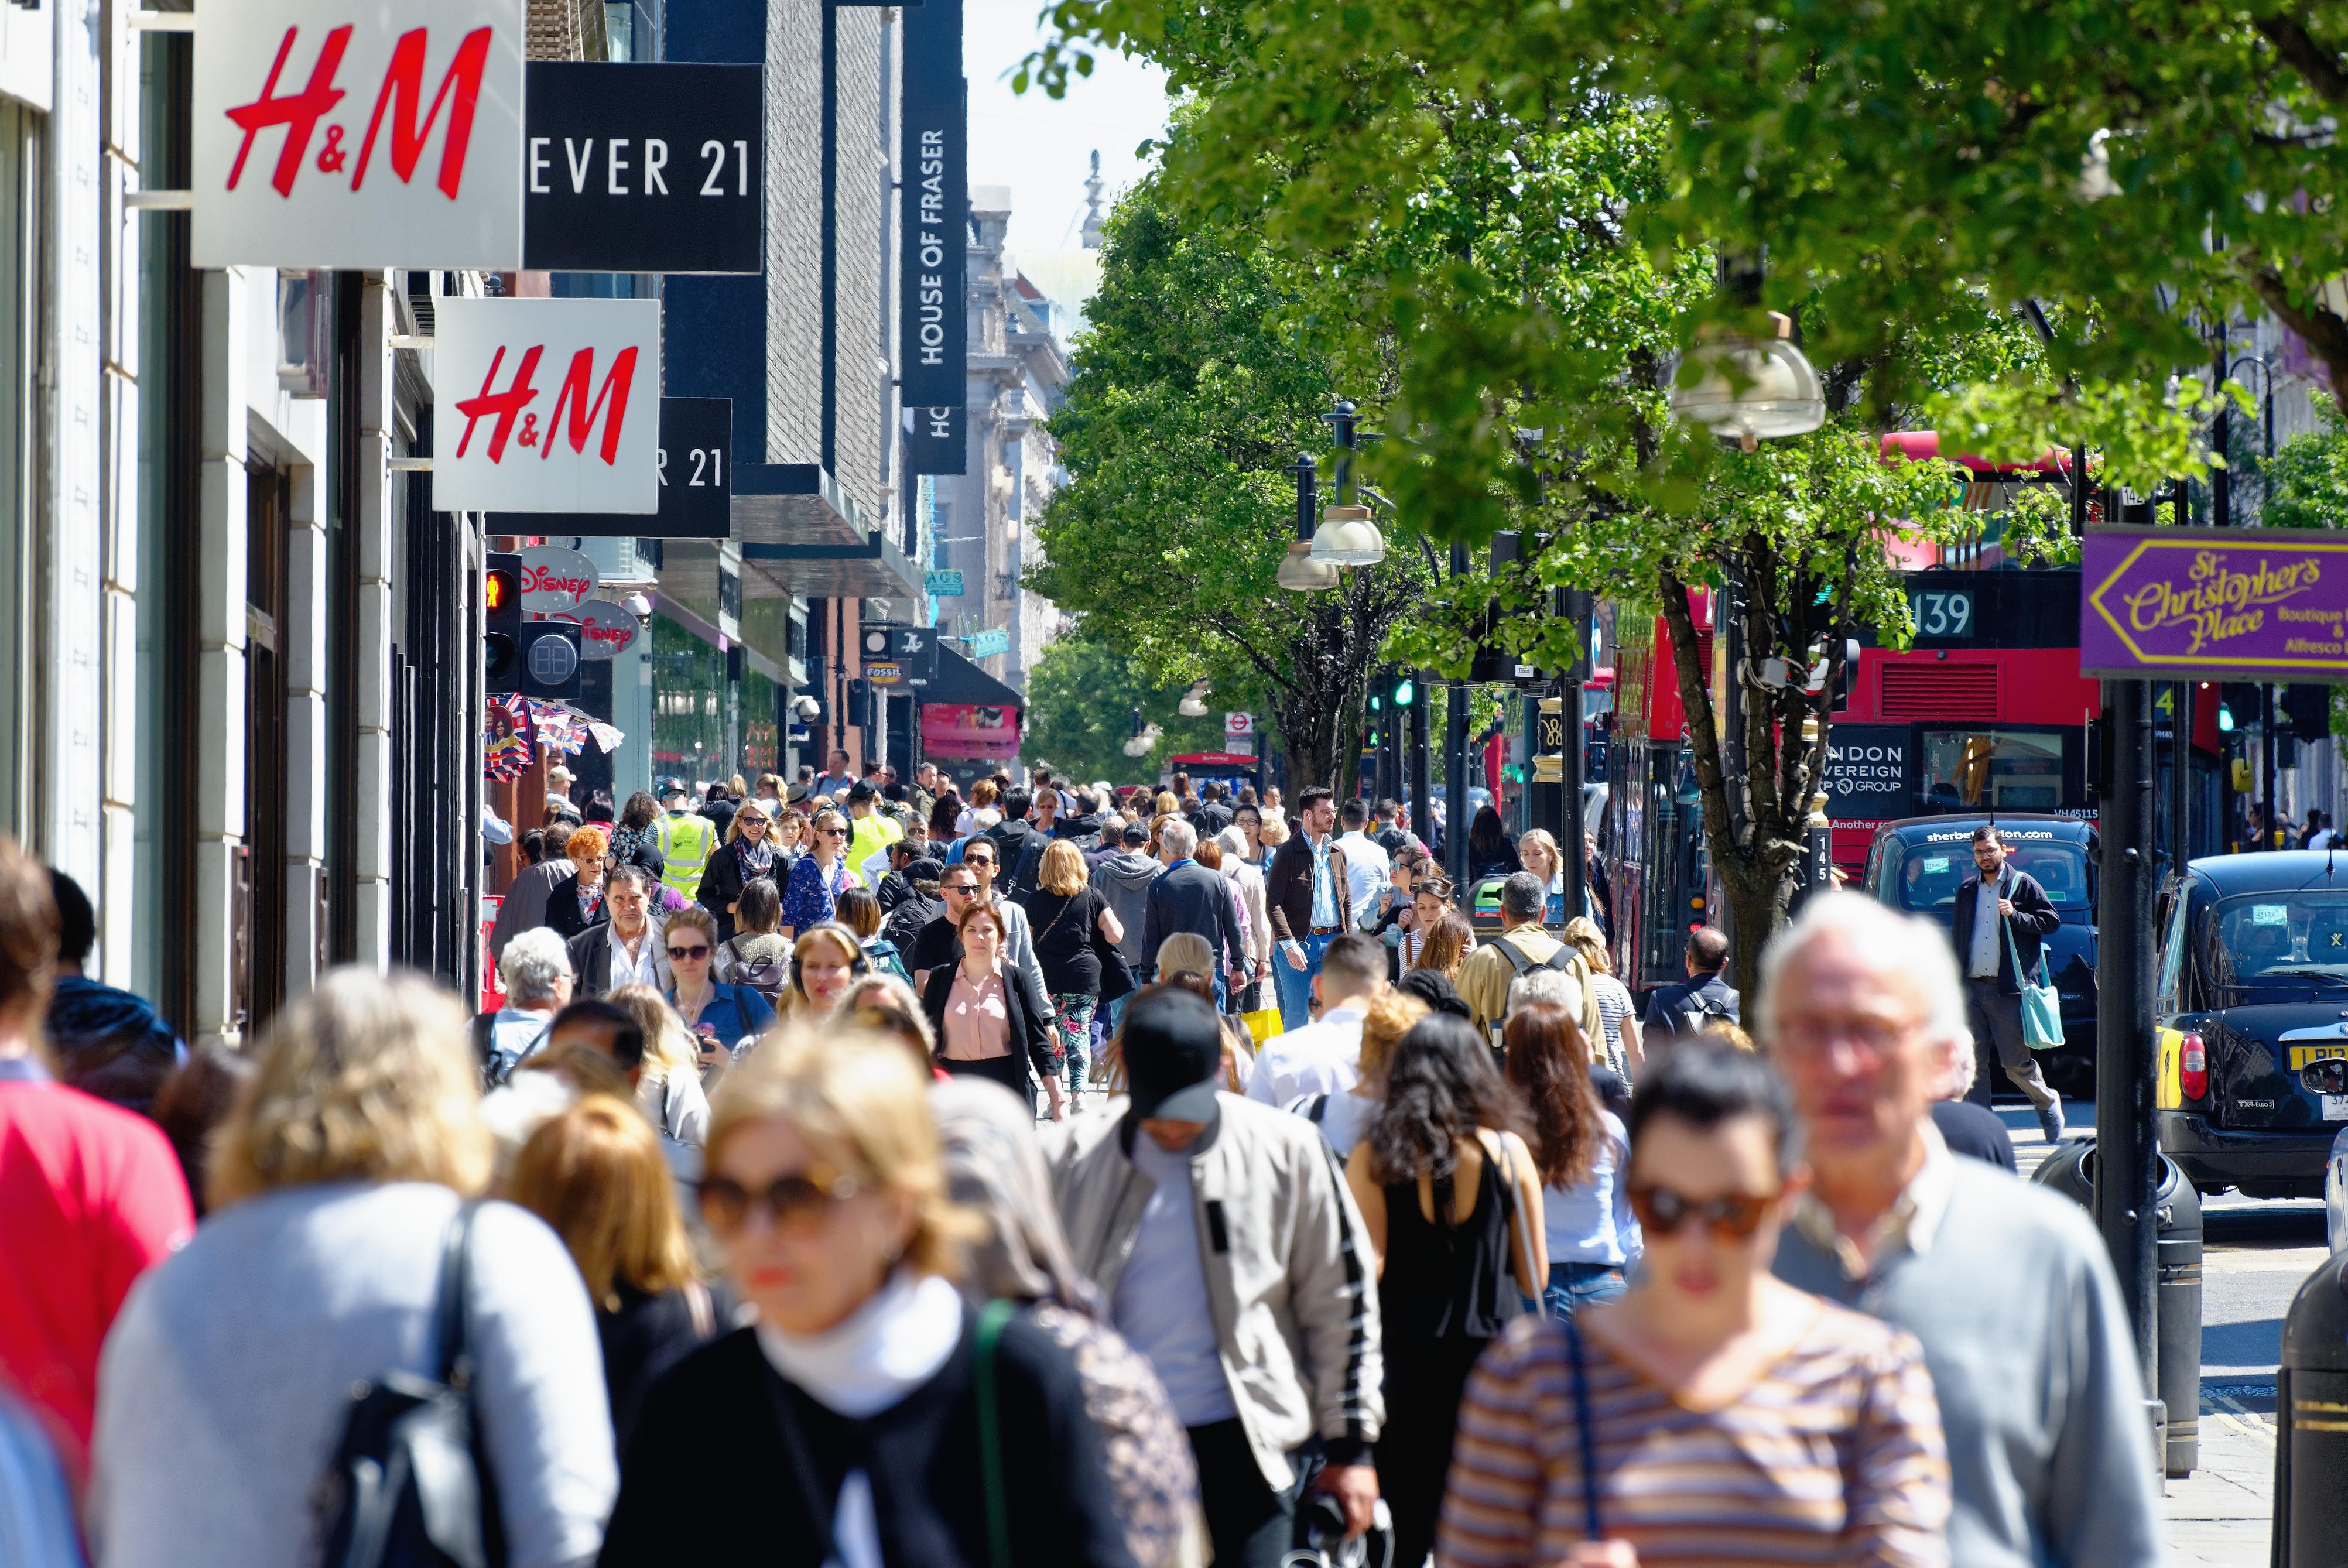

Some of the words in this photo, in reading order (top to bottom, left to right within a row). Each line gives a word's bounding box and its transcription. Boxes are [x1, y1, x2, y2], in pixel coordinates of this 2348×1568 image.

[225, 24, 492, 200] H&M
[530, 137, 669, 196] EVER
[700, 139, 747, 196] 21
[921, 129, 943, 224] FRASER
[921, 232, 943, 268] OF
[921, 275, 943, 364] HOUSE
[456, 345, 638, 465] H&M
[689, 449, 721, 487] 21
[1915, 594, 1970, 634] 139
[2162, 608, 2264, 655] Place
[2278, 607, 2342, 625] Boutique
[2333, 624, 2344, 638] &
[2285, 638, 2342, 654] Alfresco
[867, 669, 901, 677] FOSSIL
[1856, 781, 1901, 792] GROUP
[1831, 820, 1875, 829] Another
[2054, 809, 2099, 819] VH45115
[1818, 837, 1826, 881] 145
